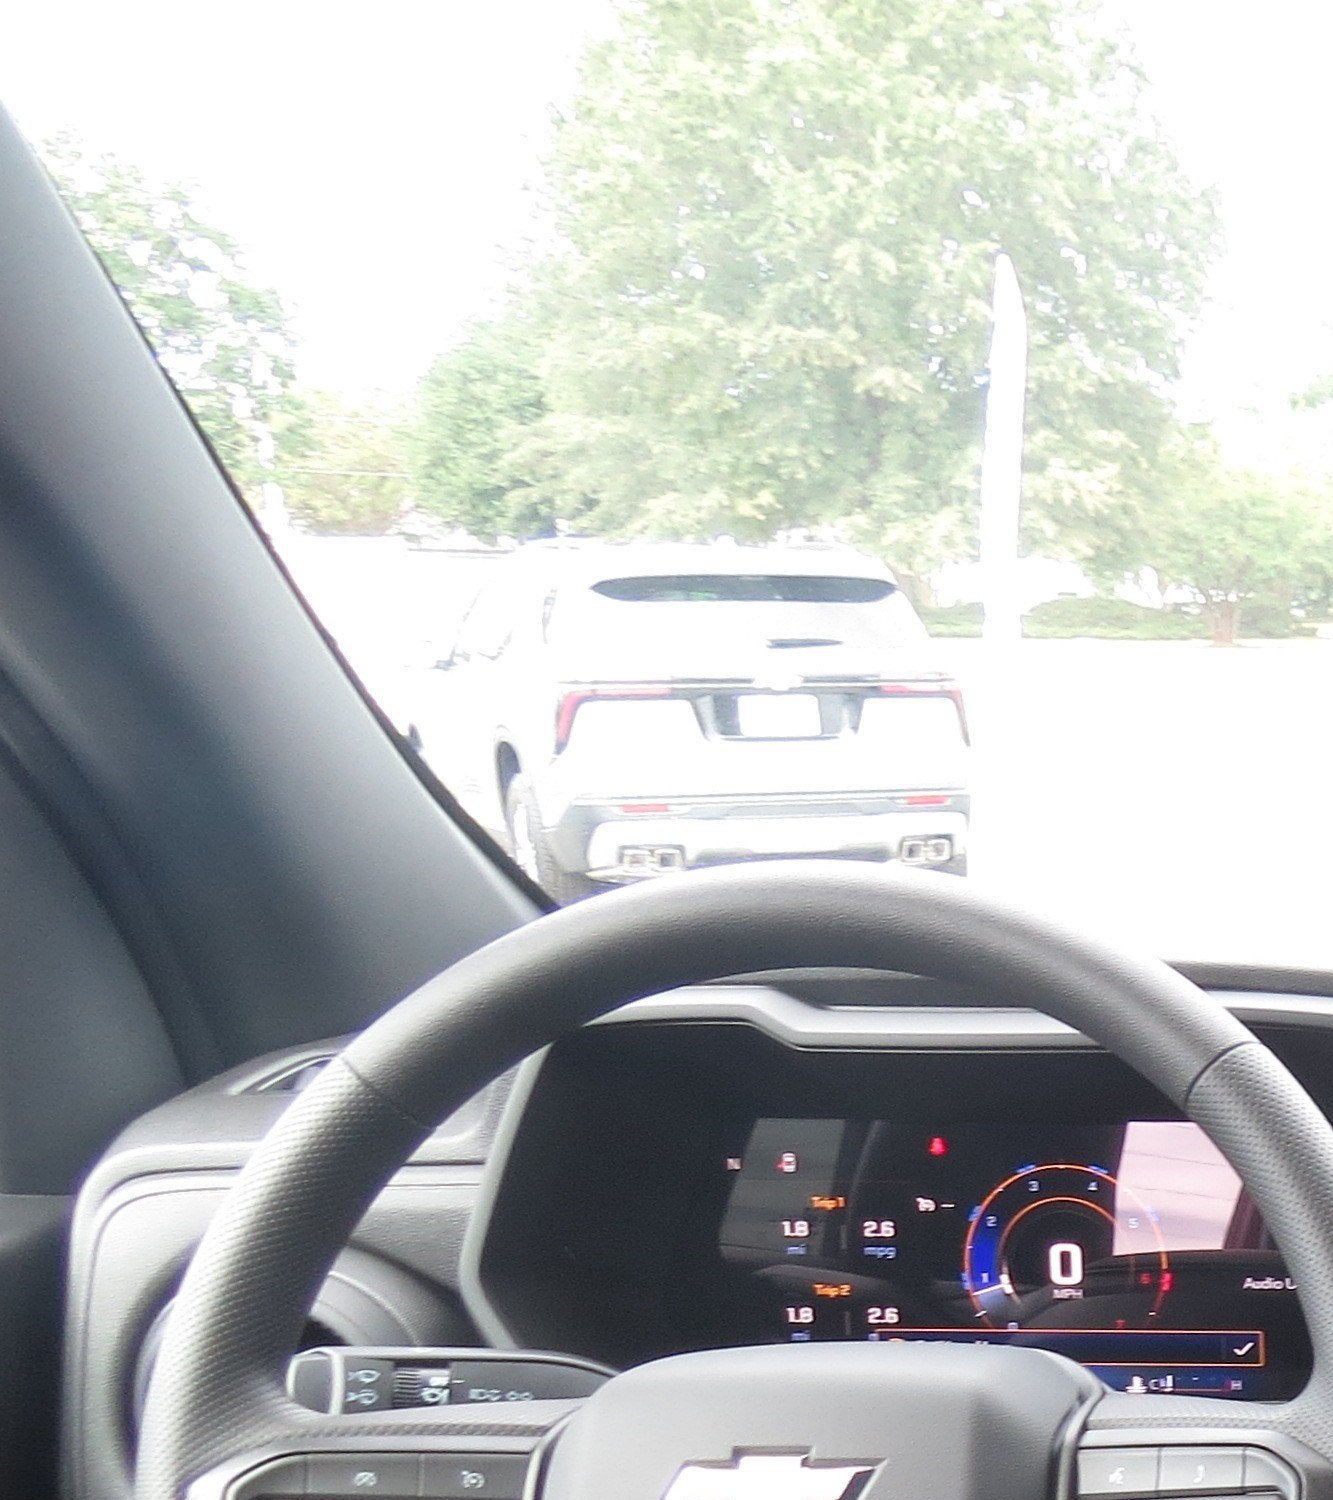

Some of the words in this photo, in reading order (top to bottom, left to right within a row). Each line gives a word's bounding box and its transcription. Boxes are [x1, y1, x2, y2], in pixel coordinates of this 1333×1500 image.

[781, 1220, 810, 1237] 1.8
[862, 1220, 896, 1238] 2.6
[1048, 1242, 1083, 1285] 0
[1242, 1276, 1285, 1290] Audio
[786, 1307, 815, 1323] 1.8
[867, 1307, 900, 1324] 2.6
